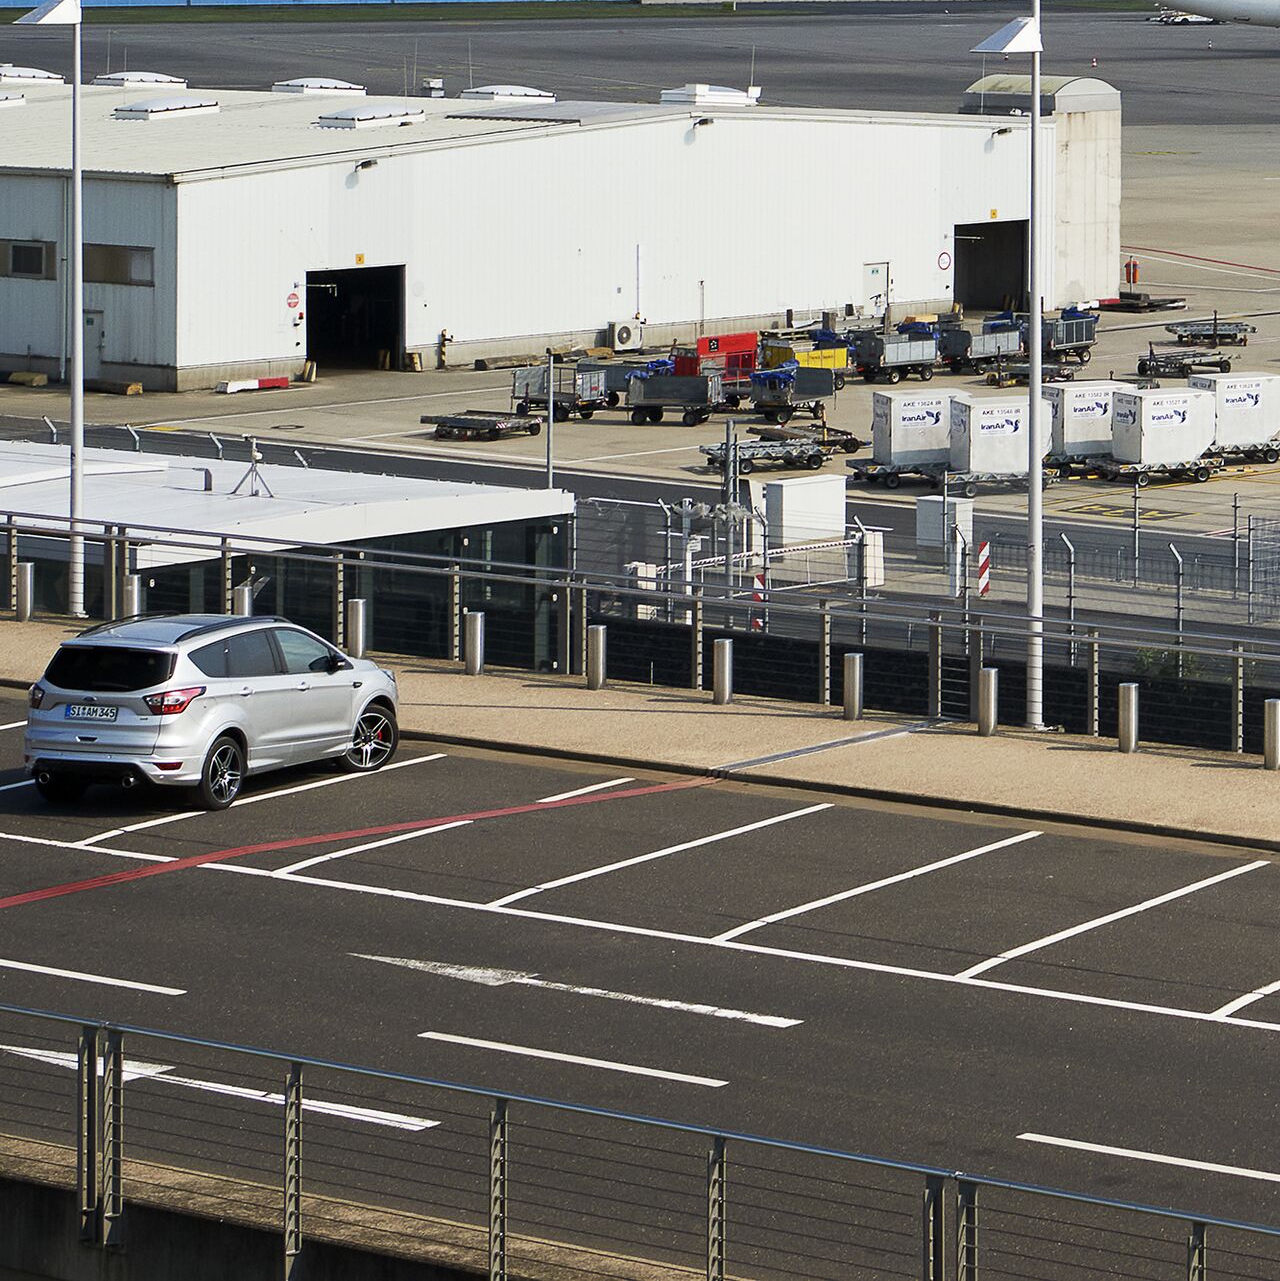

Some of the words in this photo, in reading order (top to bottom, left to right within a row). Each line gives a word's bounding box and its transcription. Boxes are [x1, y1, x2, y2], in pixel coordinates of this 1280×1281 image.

[1225, 396, 1247, 405] IranAir
[1073, 406, 1096, 414] IranAir
[901, 413, 927, 423] IranAir
[1151, 413, 1174, 422] IranAir
[980, 422, 1006, 431] IranAir
[70, 706, 80, 716] SI
[86, 706, 98, 717] AM
[98, 707, 116, 718] 345
